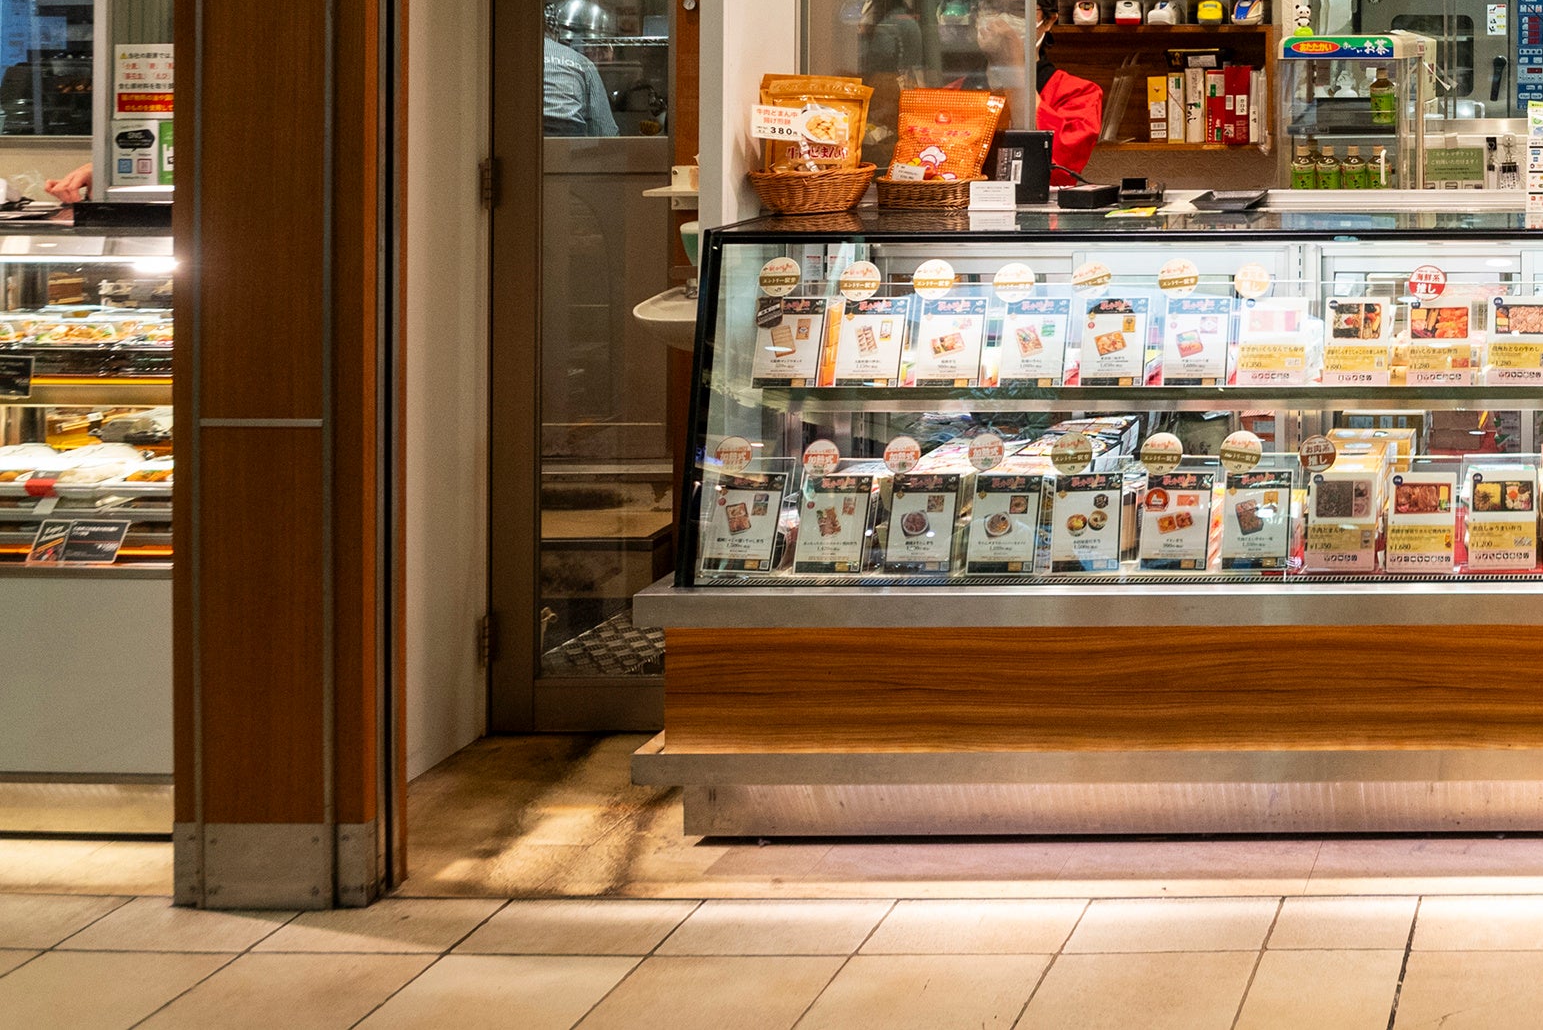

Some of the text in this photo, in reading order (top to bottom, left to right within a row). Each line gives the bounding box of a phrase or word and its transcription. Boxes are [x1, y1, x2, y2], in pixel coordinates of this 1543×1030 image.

[1298, 41, 1333, 53] あたたかい
[756, 108, 798, 118] 牛肉どまん中
[1415, 273, 1441, 283] 海鮮系
[1415, 282, 1437, 295] 推し
[1308, 454, 1328, 466] 推し
